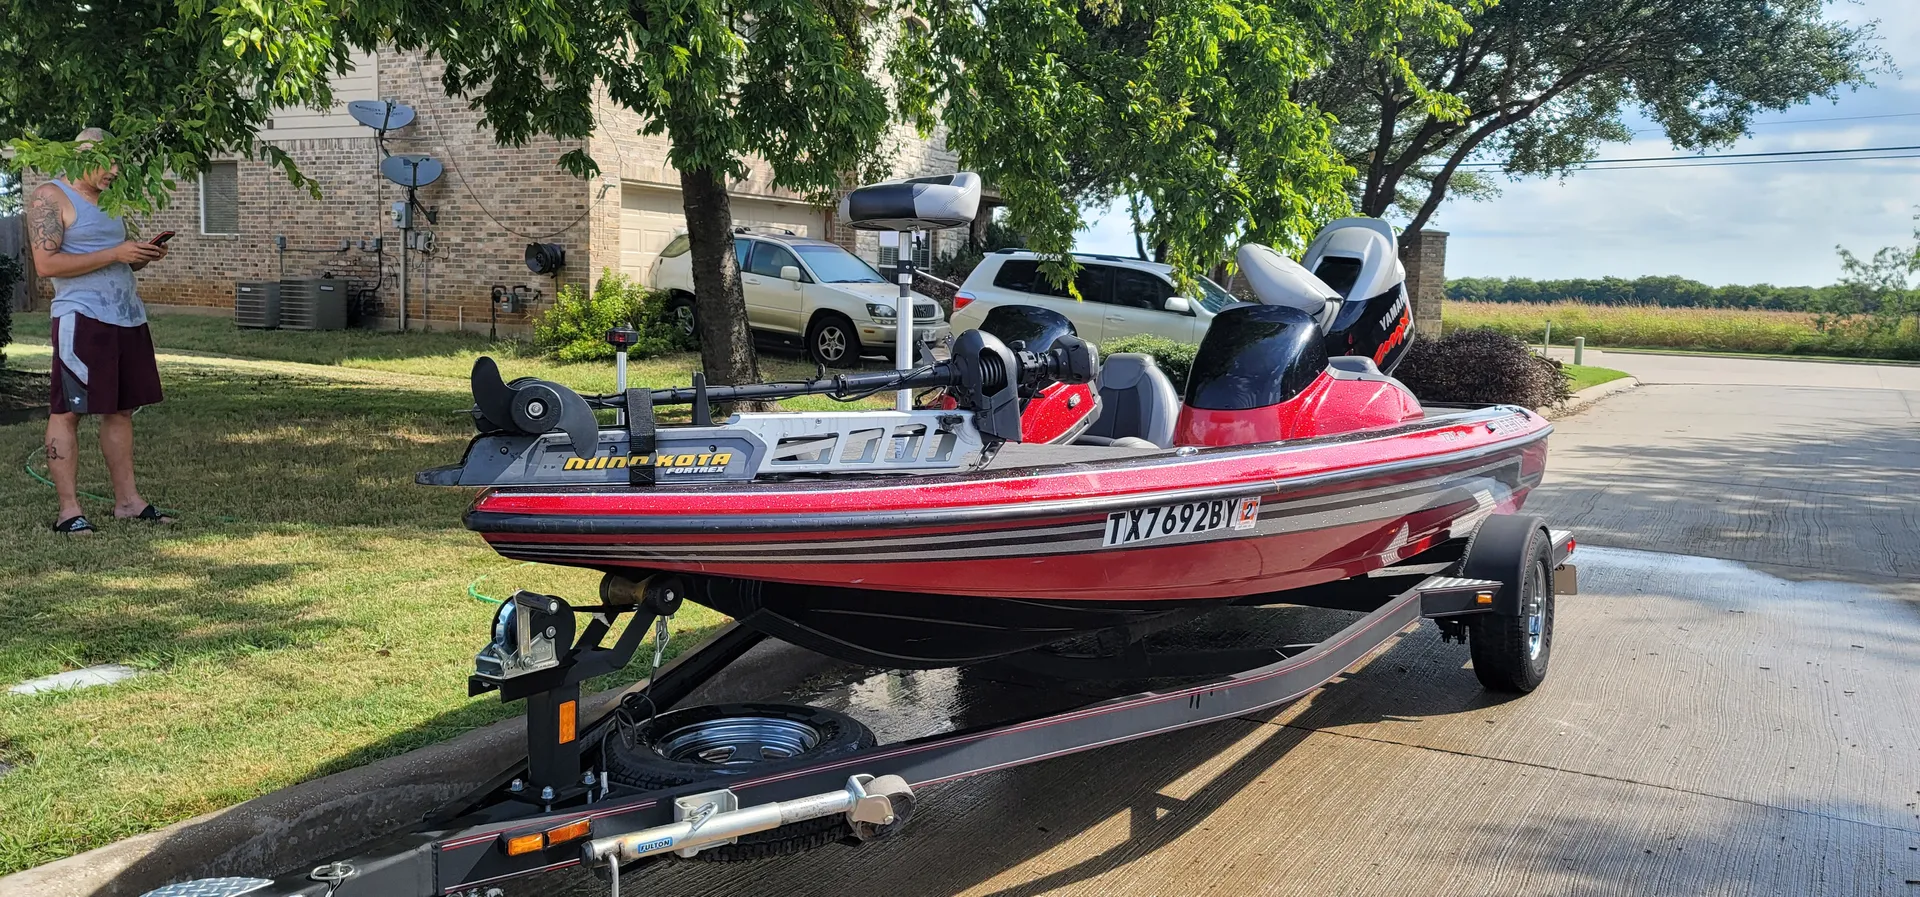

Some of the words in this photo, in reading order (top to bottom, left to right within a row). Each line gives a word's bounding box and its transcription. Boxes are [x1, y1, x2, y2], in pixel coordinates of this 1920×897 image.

[1378, 292, 1407, 331] YAMAH
[655, 452, 733, 468] KOTA
[665, 465, 726, 475] FORTREX
[1244, 502, 1254, 520] 2
[1109, 498, 1240, 545] TX7692BY
[640, 839, 670, 852] FULTON
